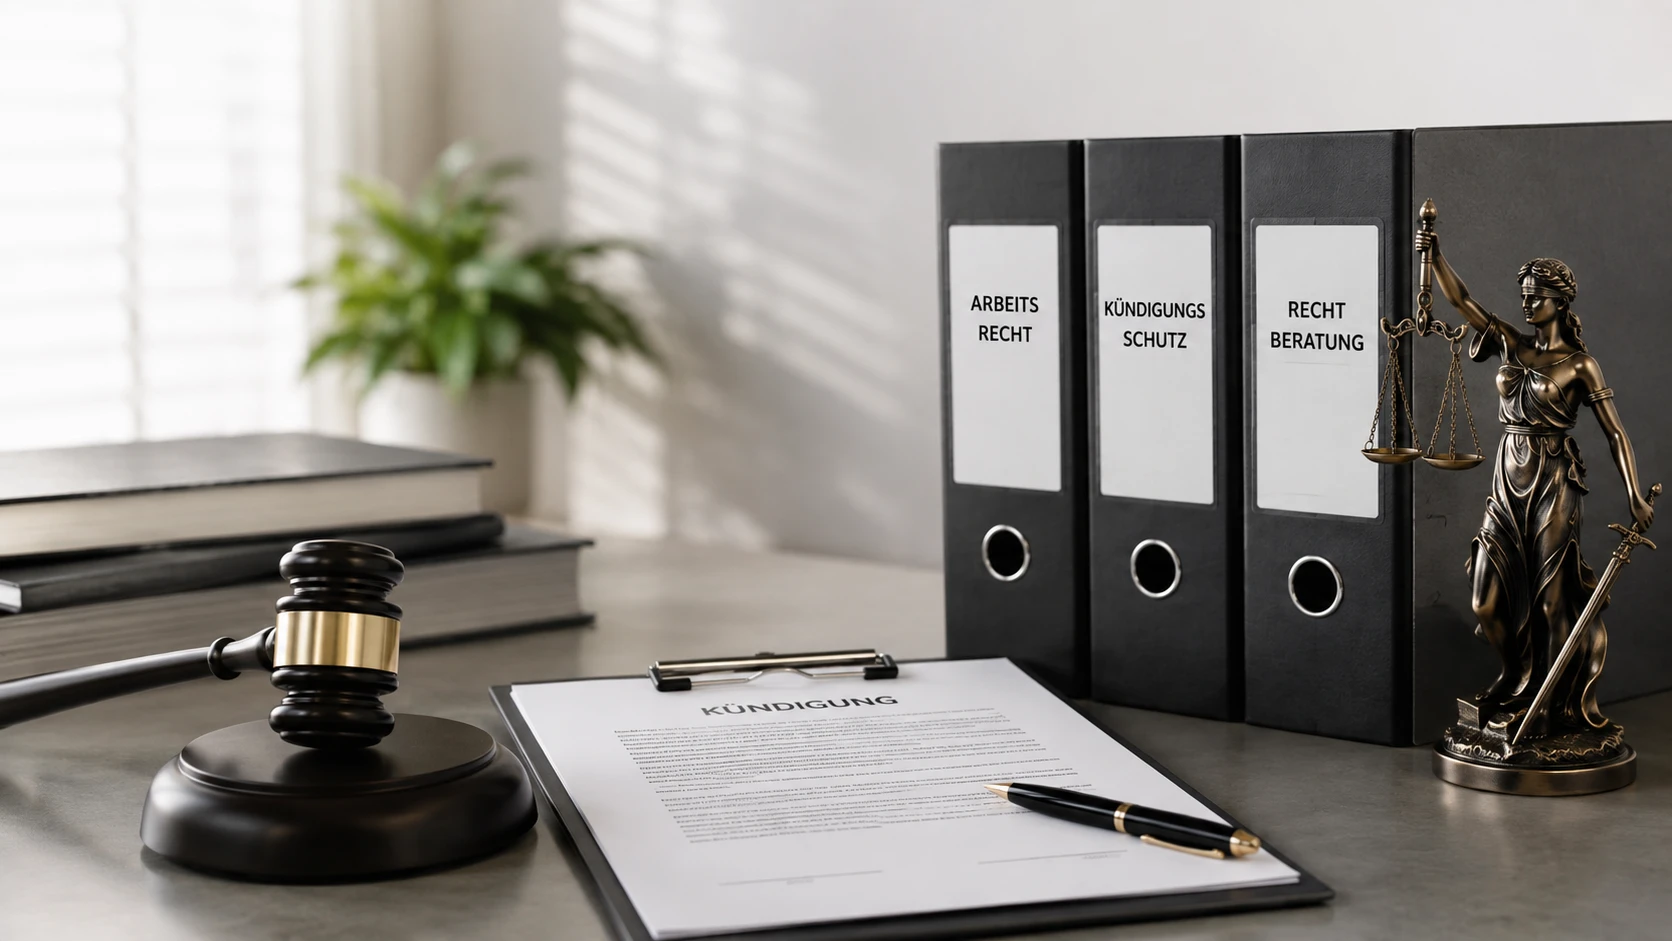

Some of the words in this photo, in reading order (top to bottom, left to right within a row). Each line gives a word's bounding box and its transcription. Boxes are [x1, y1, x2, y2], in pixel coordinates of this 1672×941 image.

[970, 294, 1039, 314] ARBEITS
[1104, 297, 1206, 320] KÜNDIGUNGS
[1288, 300, 1347, 320] RECHT
[978, 324, 1033, 343] RECHT
[1123, 330, 1188, 349] SCHUTZ
[1270, 331, 1365, 352] BERATUNG
[701, 695, 899, 717] KÜNDIGUNG
